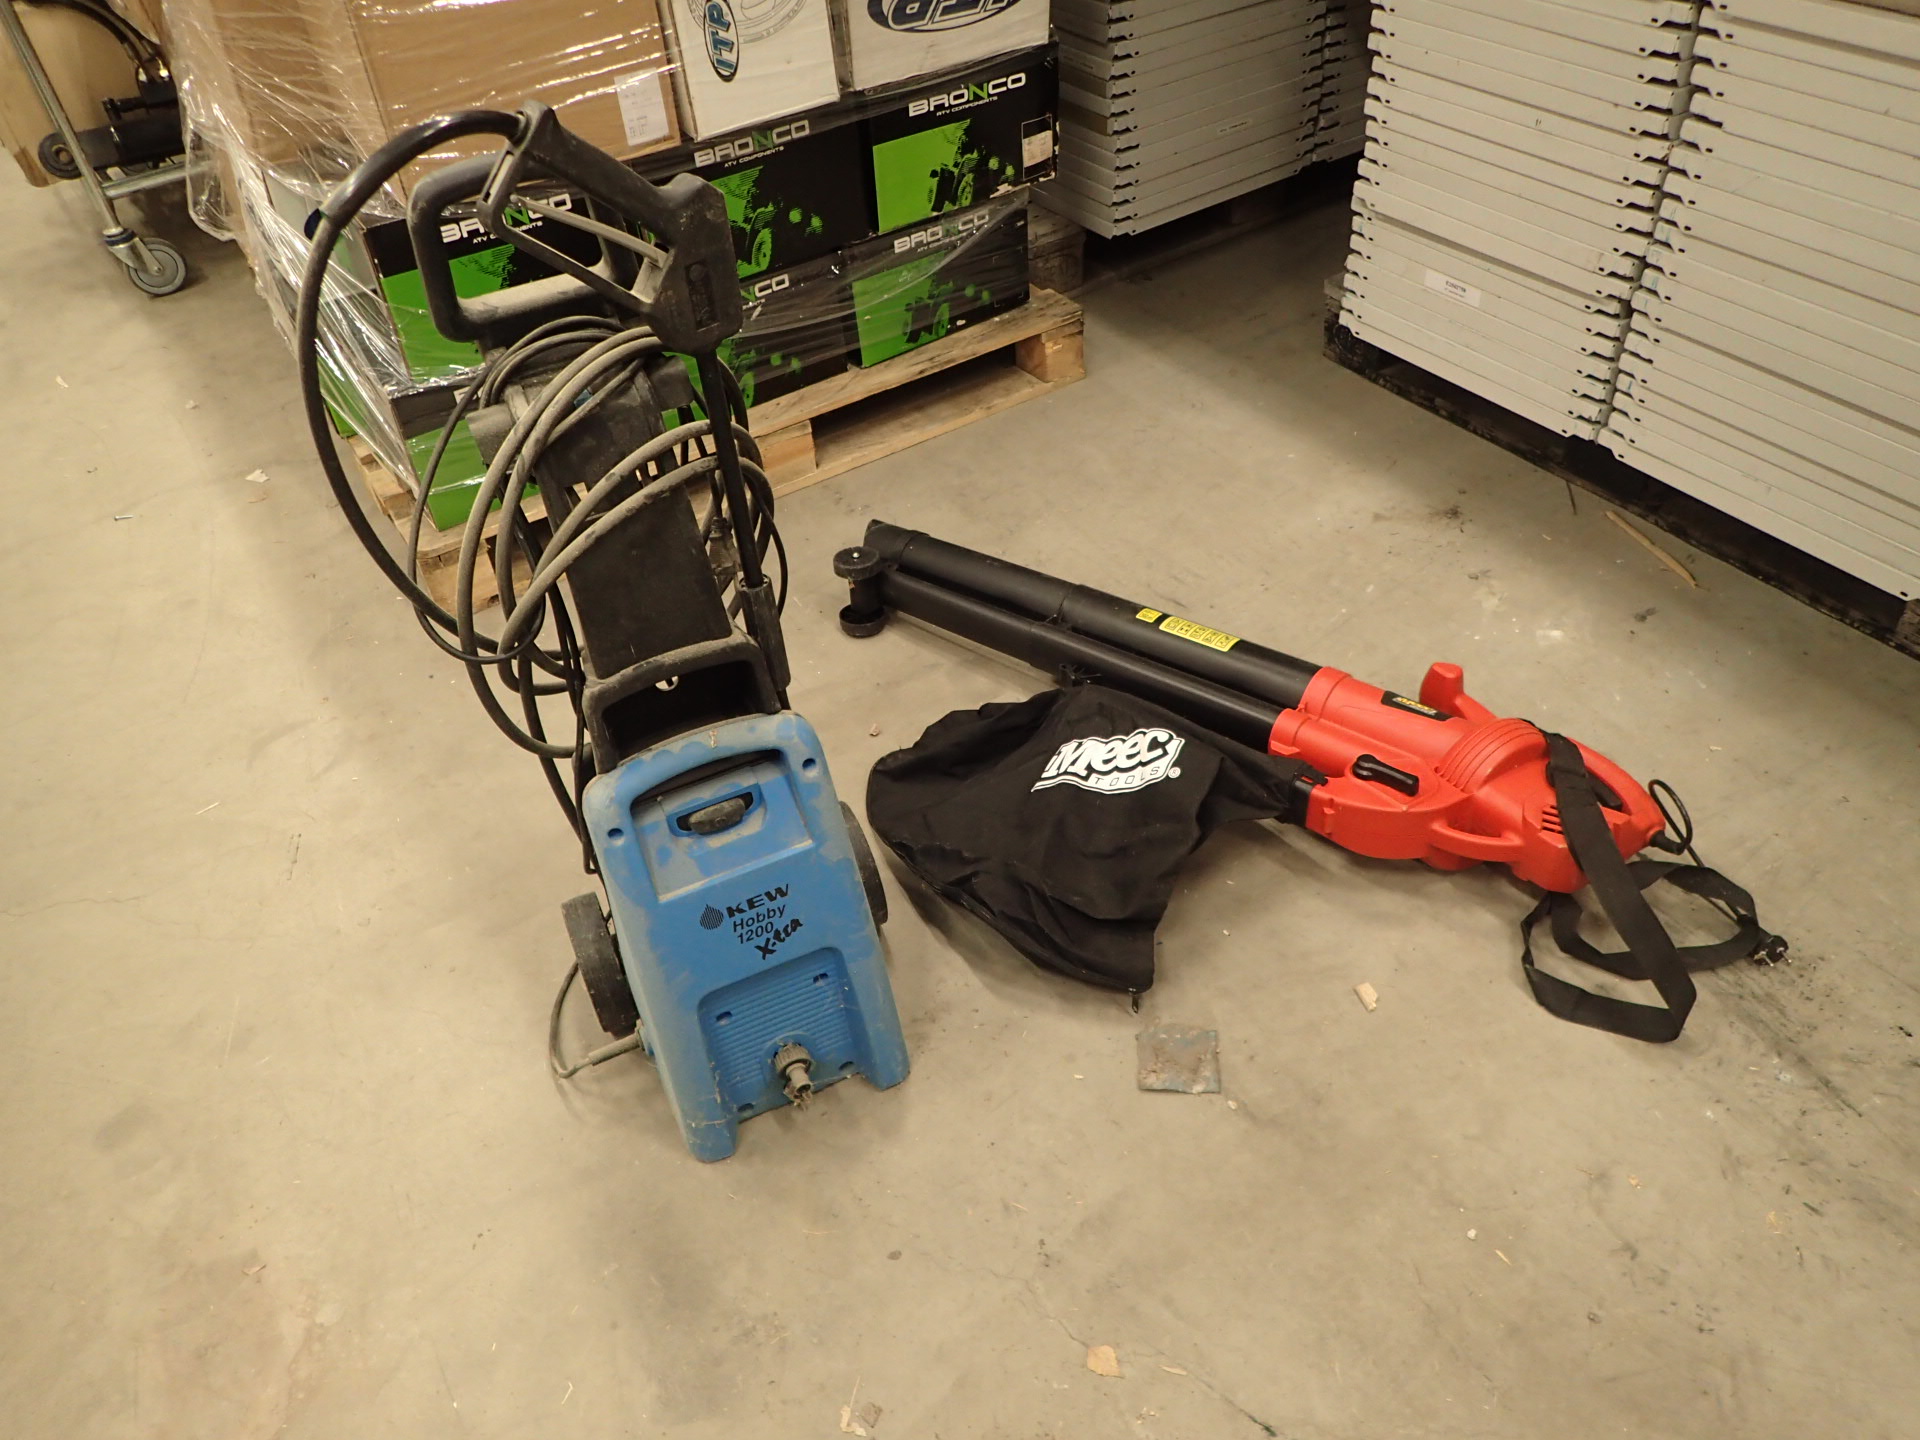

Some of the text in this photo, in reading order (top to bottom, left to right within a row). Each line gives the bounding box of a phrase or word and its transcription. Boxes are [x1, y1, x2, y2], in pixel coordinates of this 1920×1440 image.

[705, 1, 737, 73] ITP
[908, 72, 1026, 117] BRONCO
[936, 96, 998, 117] ATV COMPONENTS
[694, 119, 810, 168] BRONCO
[724, 145, 785, 168] ATV COMPONENTS
[472, 235, 488, 244] ATV
[1094, 766, 1160, 787] TOOLS
[725, 883, 790, 919] KEW
[732, 904, 786, 933] Hobby
[737, 921, 774, 945] 1200
